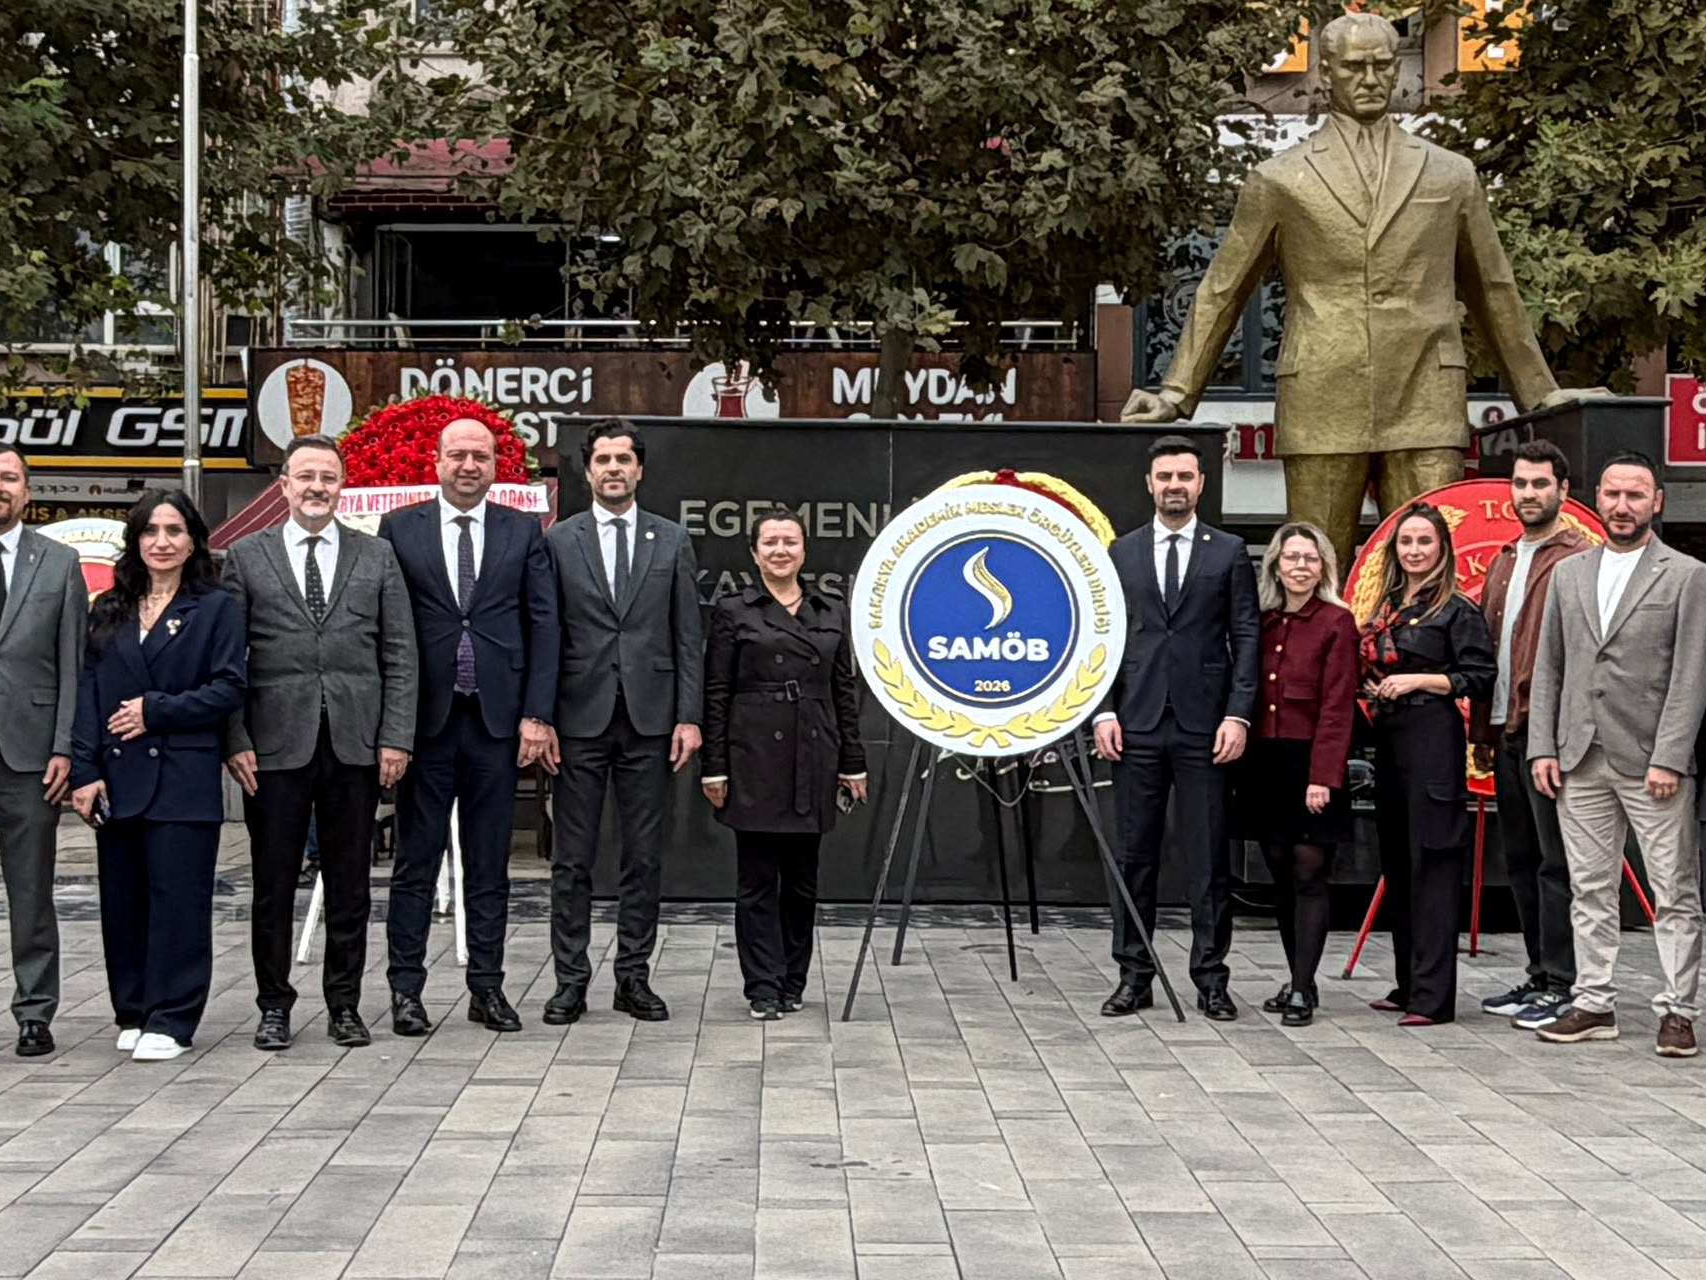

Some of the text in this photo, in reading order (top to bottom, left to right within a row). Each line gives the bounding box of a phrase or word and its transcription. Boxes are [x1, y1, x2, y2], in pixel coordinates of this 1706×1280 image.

[105, 406, 249, 448] GSM
[964, 500, 1027, 519] MESLEK
[927, 631, 1050, 662] SAMÖB
[973, 679, 1012, 693] 2026
